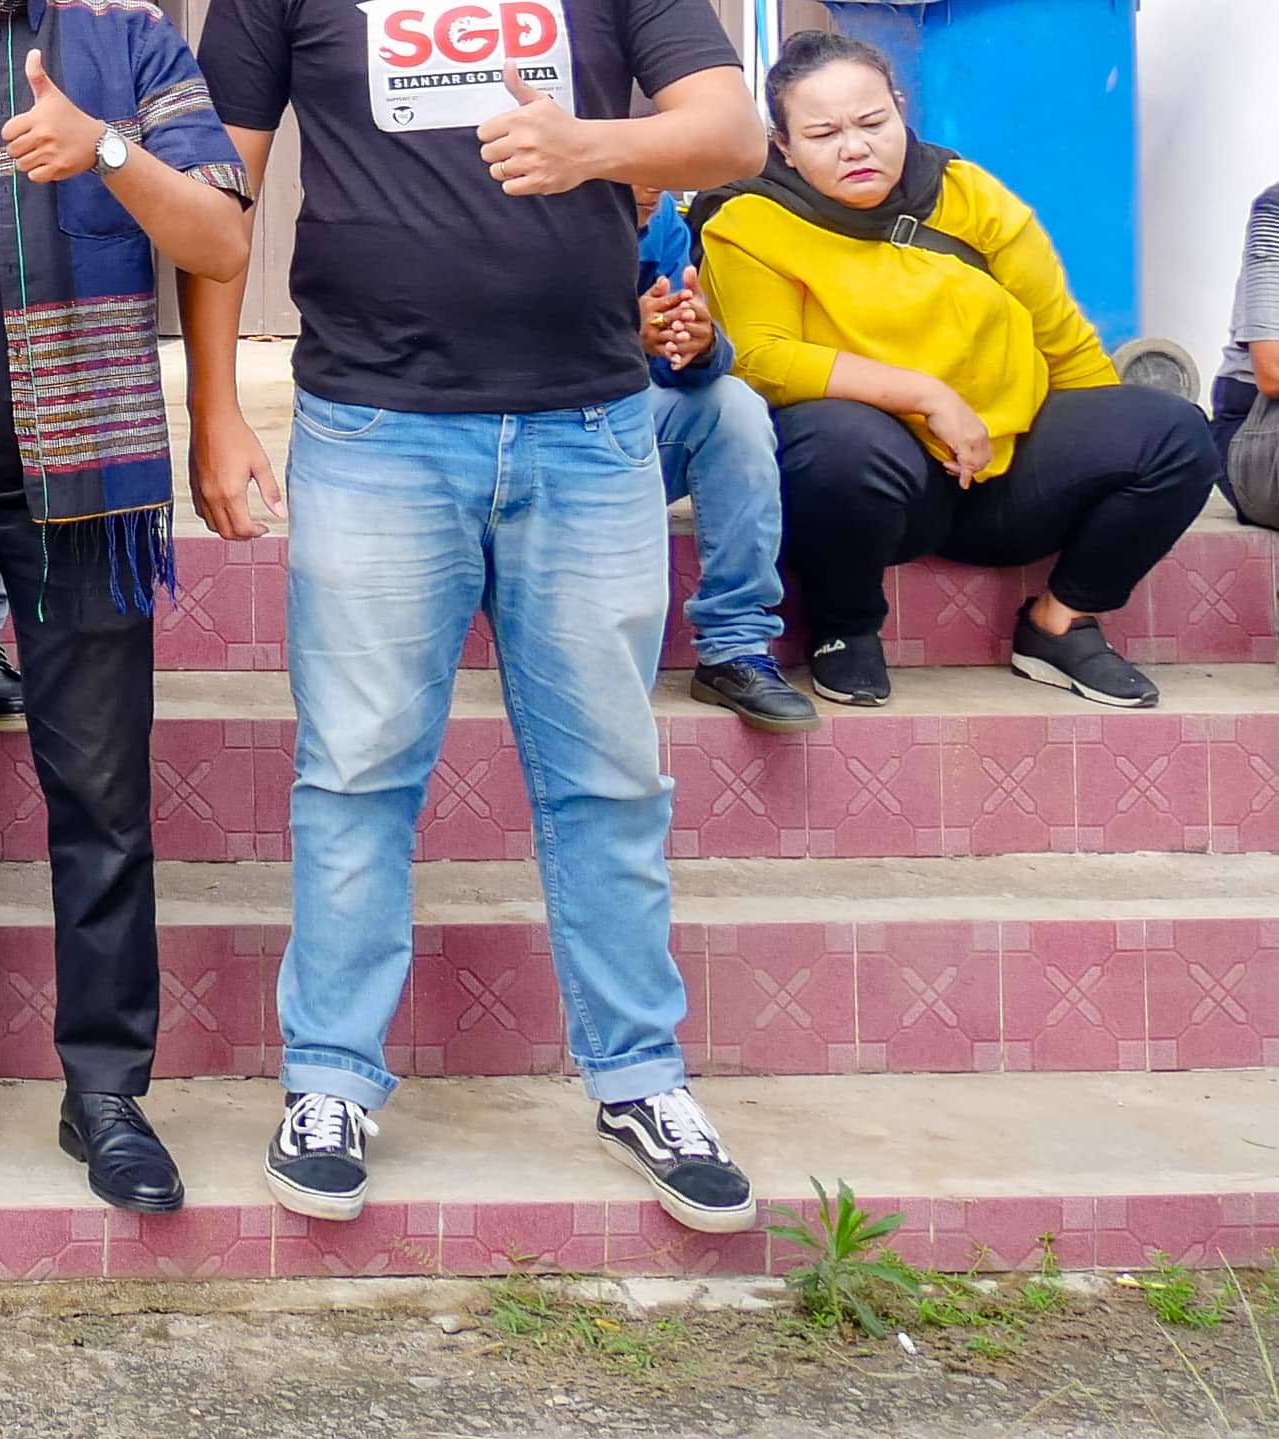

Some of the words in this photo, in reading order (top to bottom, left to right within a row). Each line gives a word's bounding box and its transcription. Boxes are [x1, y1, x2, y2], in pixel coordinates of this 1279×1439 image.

[379, 1, 558, 68] SGD
[394, 74, 461, 89] SIANTAR
[465, 71, 489, 83] GO
[493, 68, 553, 82] DITAL
